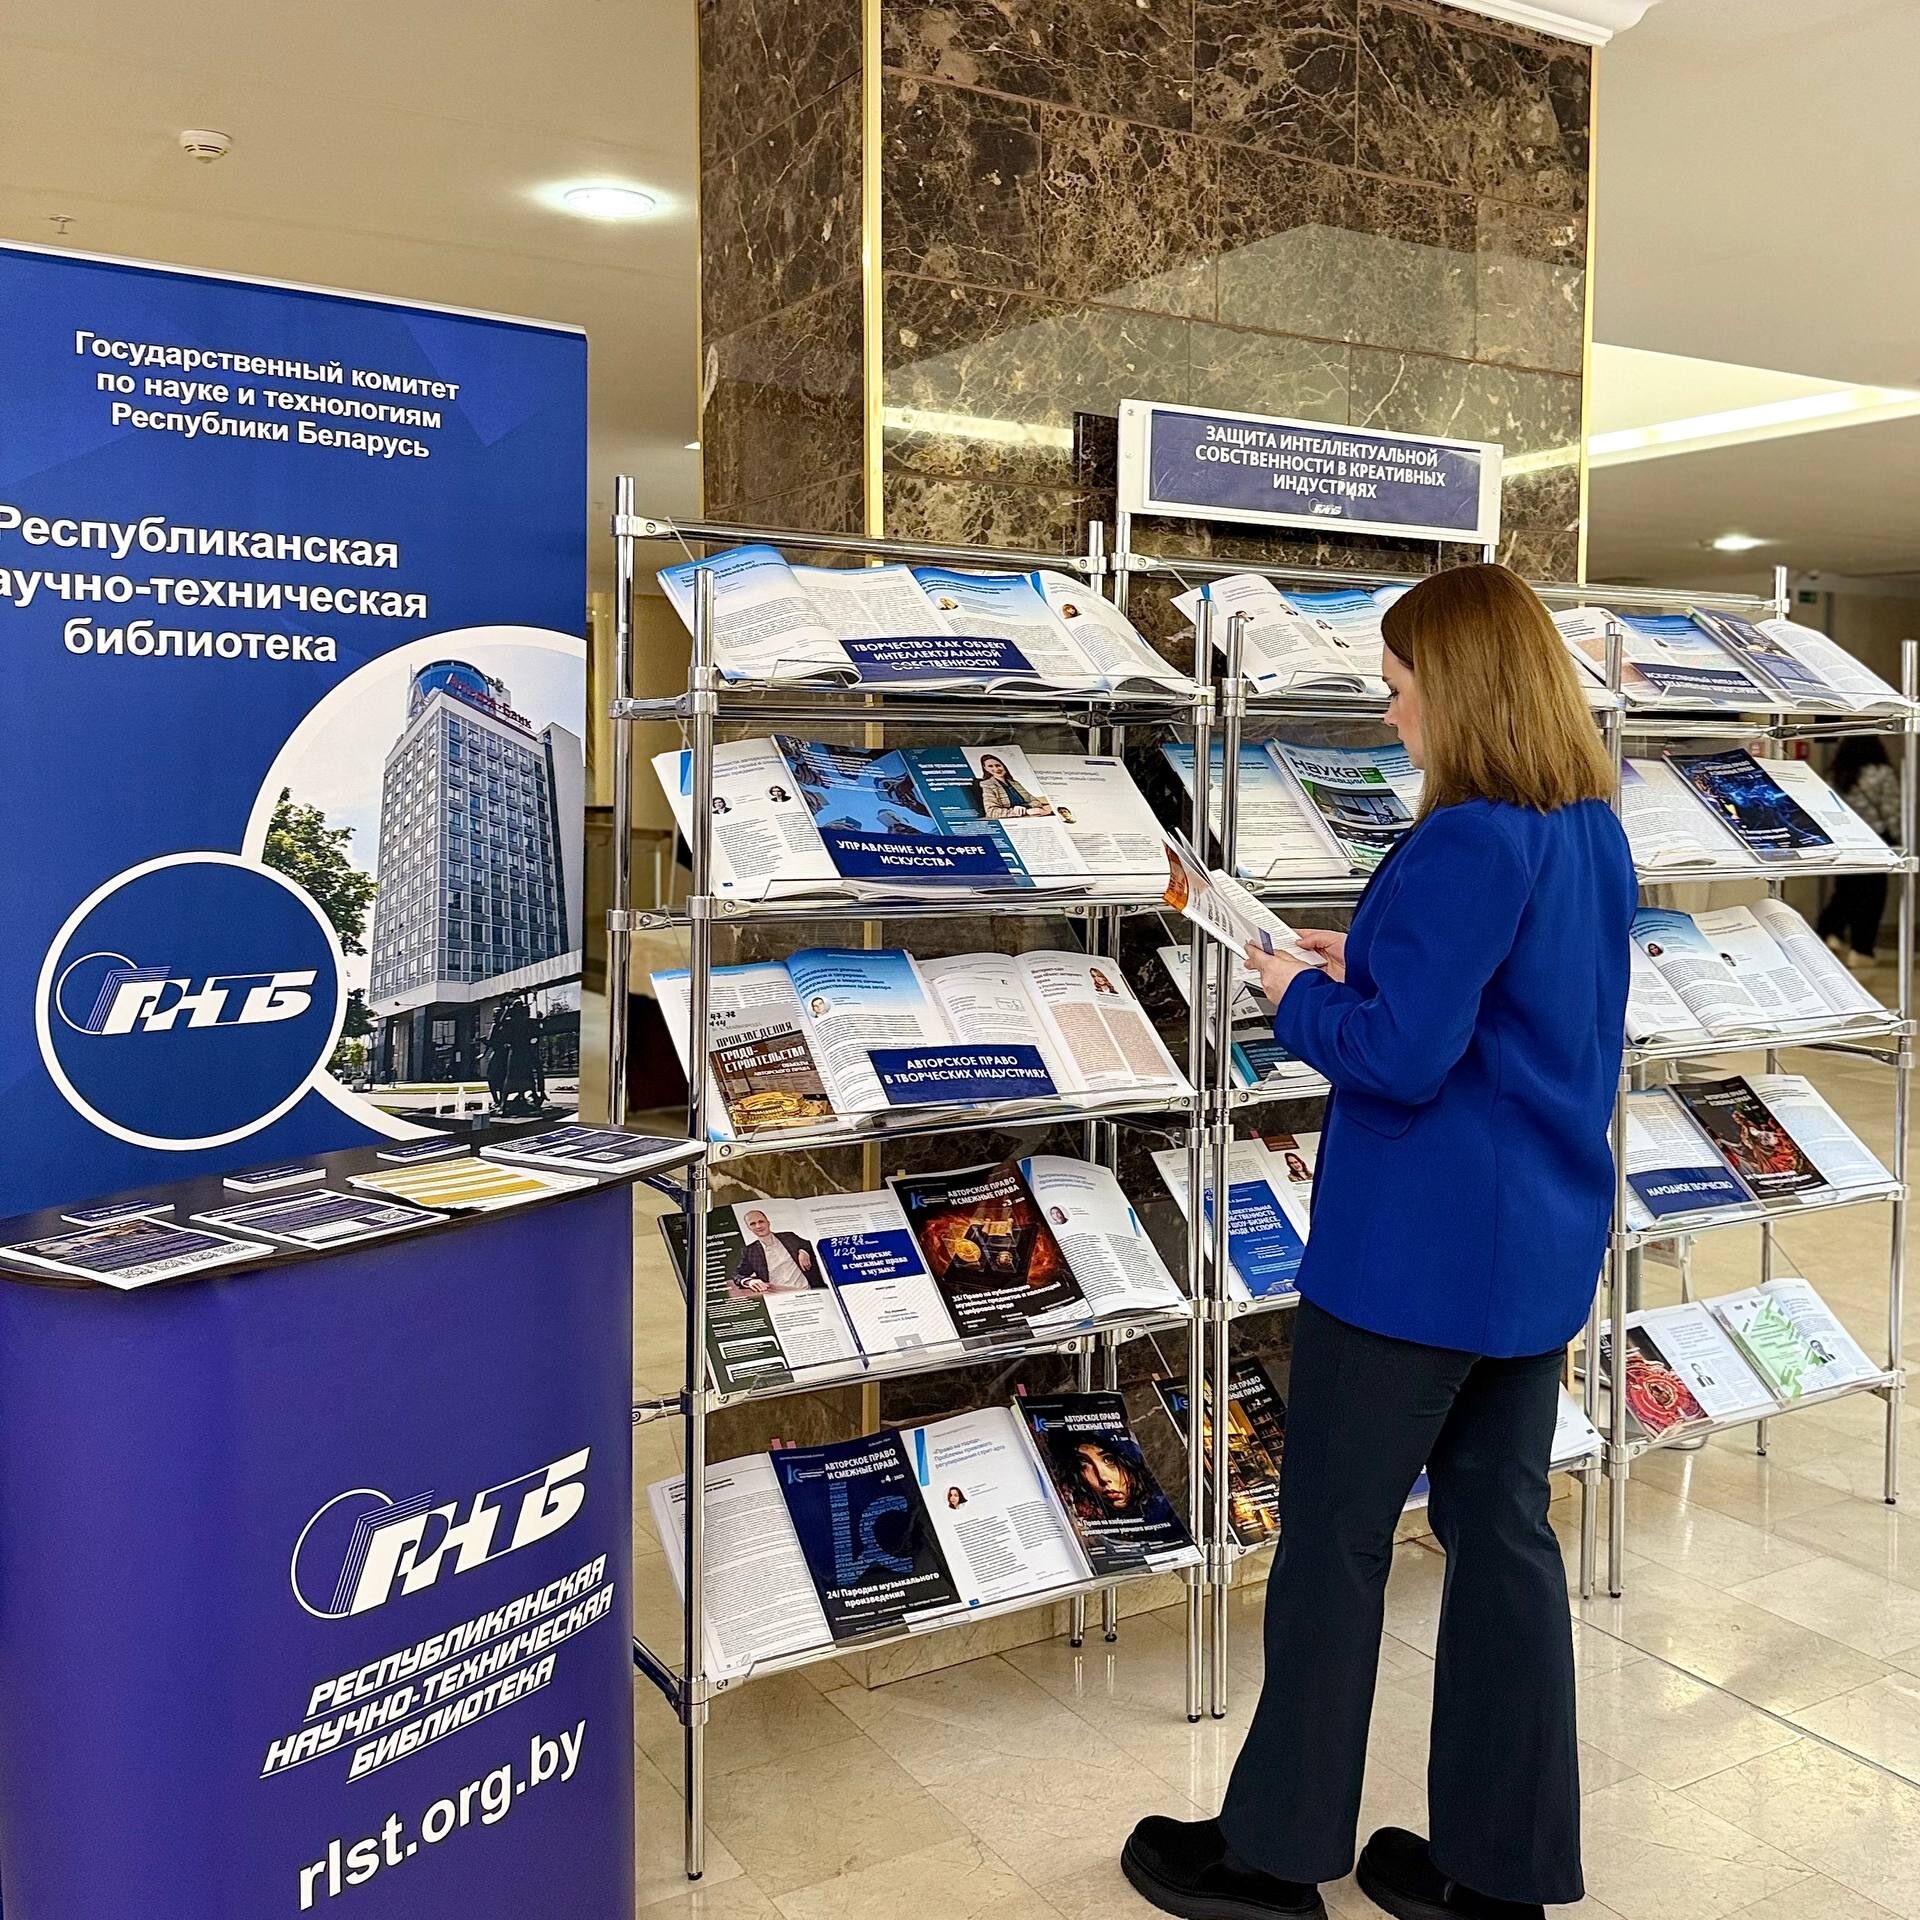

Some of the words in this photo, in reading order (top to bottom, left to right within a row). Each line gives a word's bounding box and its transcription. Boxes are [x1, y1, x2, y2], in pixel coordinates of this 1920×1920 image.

[75, 330, 343, 384] Государственный
[351, 368, 460, 400] комитет
[97, 372, 136, 396] по
[144, 376, 229, 406] науке
[238, 390, 256, 406] и
[263, 389, 442, 429] технологиям
[111, 402, 289, 442] Республики
[298, 421, 430, 461] Беларусь
[1205, 424, 1277, 449] ЗАЩИТА
[1279, 433, 1438, 468] ИНТЕЛЛЕКТУАЛЬНОЙ
[1195, 445, 1334, 475] СОБСТВЕННОСТИ
[1337, 461, 1347, 475] В
[1350, 462, 1446, 488] КРЕАТИВНЫХ
[1272, 473, 1378, 500] ИНДУСТРИЯХ
[0, 505, 399, 569] Республиканская
[0, 567, 428, 619] аучно-техническая
[63, 617, 338, 662] библиотека
[851, 641, 934, 652] ТВОРЧЕСТВО
[936, 641, 962, 649] КАК
[963, 641, 1007, 650] ОБЪЕКТ
[873, 650, 1002, 661] ИНТЕЛЛЕКТУАЛЬНОЙ
[1290, 757, 1361, 778] Наука
[836, 840, 914, 855] УПРАВЛЕНИЕ
[917, 846, 936, 855] ИС
[937, 847, 944, 855] В
[946, 846, 985, 855] СФЕРЕ
[880, 855, 955, 867] ИСКУССТВА
[907, 1056, 977, 1070] АВТОРСКОЕ
[979, 1055, 1018, 1067] ПРАВО
[885, 1074, 893, 1084] В
[894, 1069, 973, 1083] ТВОРЧЕСКИХ
[974, 1066, 1048, 1079] ИНДУСТРИЯХ
[947, 1183, 990, 1198] АВТОРСКОЕ
[990, 1177, 1015, 1189] ПРАВО
[957, 1192, 995, 1205] СМЕЖНЫЕ
[995, 1184, 1019, 1198] ПРАВА
[1646, 1183, 1692, 1197] НАРОДНОЕ
[1228, 1210, 1276, 1222] БСТВЕННОСТЬ
[849, 1260, 884, 1269] смежные
[885, 1256, 908, 1265] права
[852, 1250, 892, 1260] Авторские
[867, 1266, 896, 1276] музыке
[1238, 1376, 1260, 1389] ПРАВО
[1243, 1384, 1266, 1397] ПРАВА
[1064, 1413, 1098, 1423] АВТОРСКОЕ
[1099, 1412, 1120, 1420] ПРАВО
[1103, 1421, 1124, 1429] ПРАВА
[825, 1456, 869, 1471] АВТОРСКОЕ
[869, 1448, 896, 1461] ПРАВО
[834, 1465, 873, 1479] СМЕЖНЫЕ
[873, 1458, 899, 1471] ПРАВА
[841, 1584, 878, 1598] Пародия
[879, 1572, 939, 1591] музыкального
[845, 1590, 905, 1608] произведения
[304, 1553, 607, 1720] РЕСПУБЛИКАНСКАЯ
[260, 1583, 615, 1776] НАУЧНО-ТЕХНИЧЕСКАЯ
[346, 1653, 557, 1782] БИБЛИОТЕКА
[299, 1720, 586, 1911] rlst.org.by
